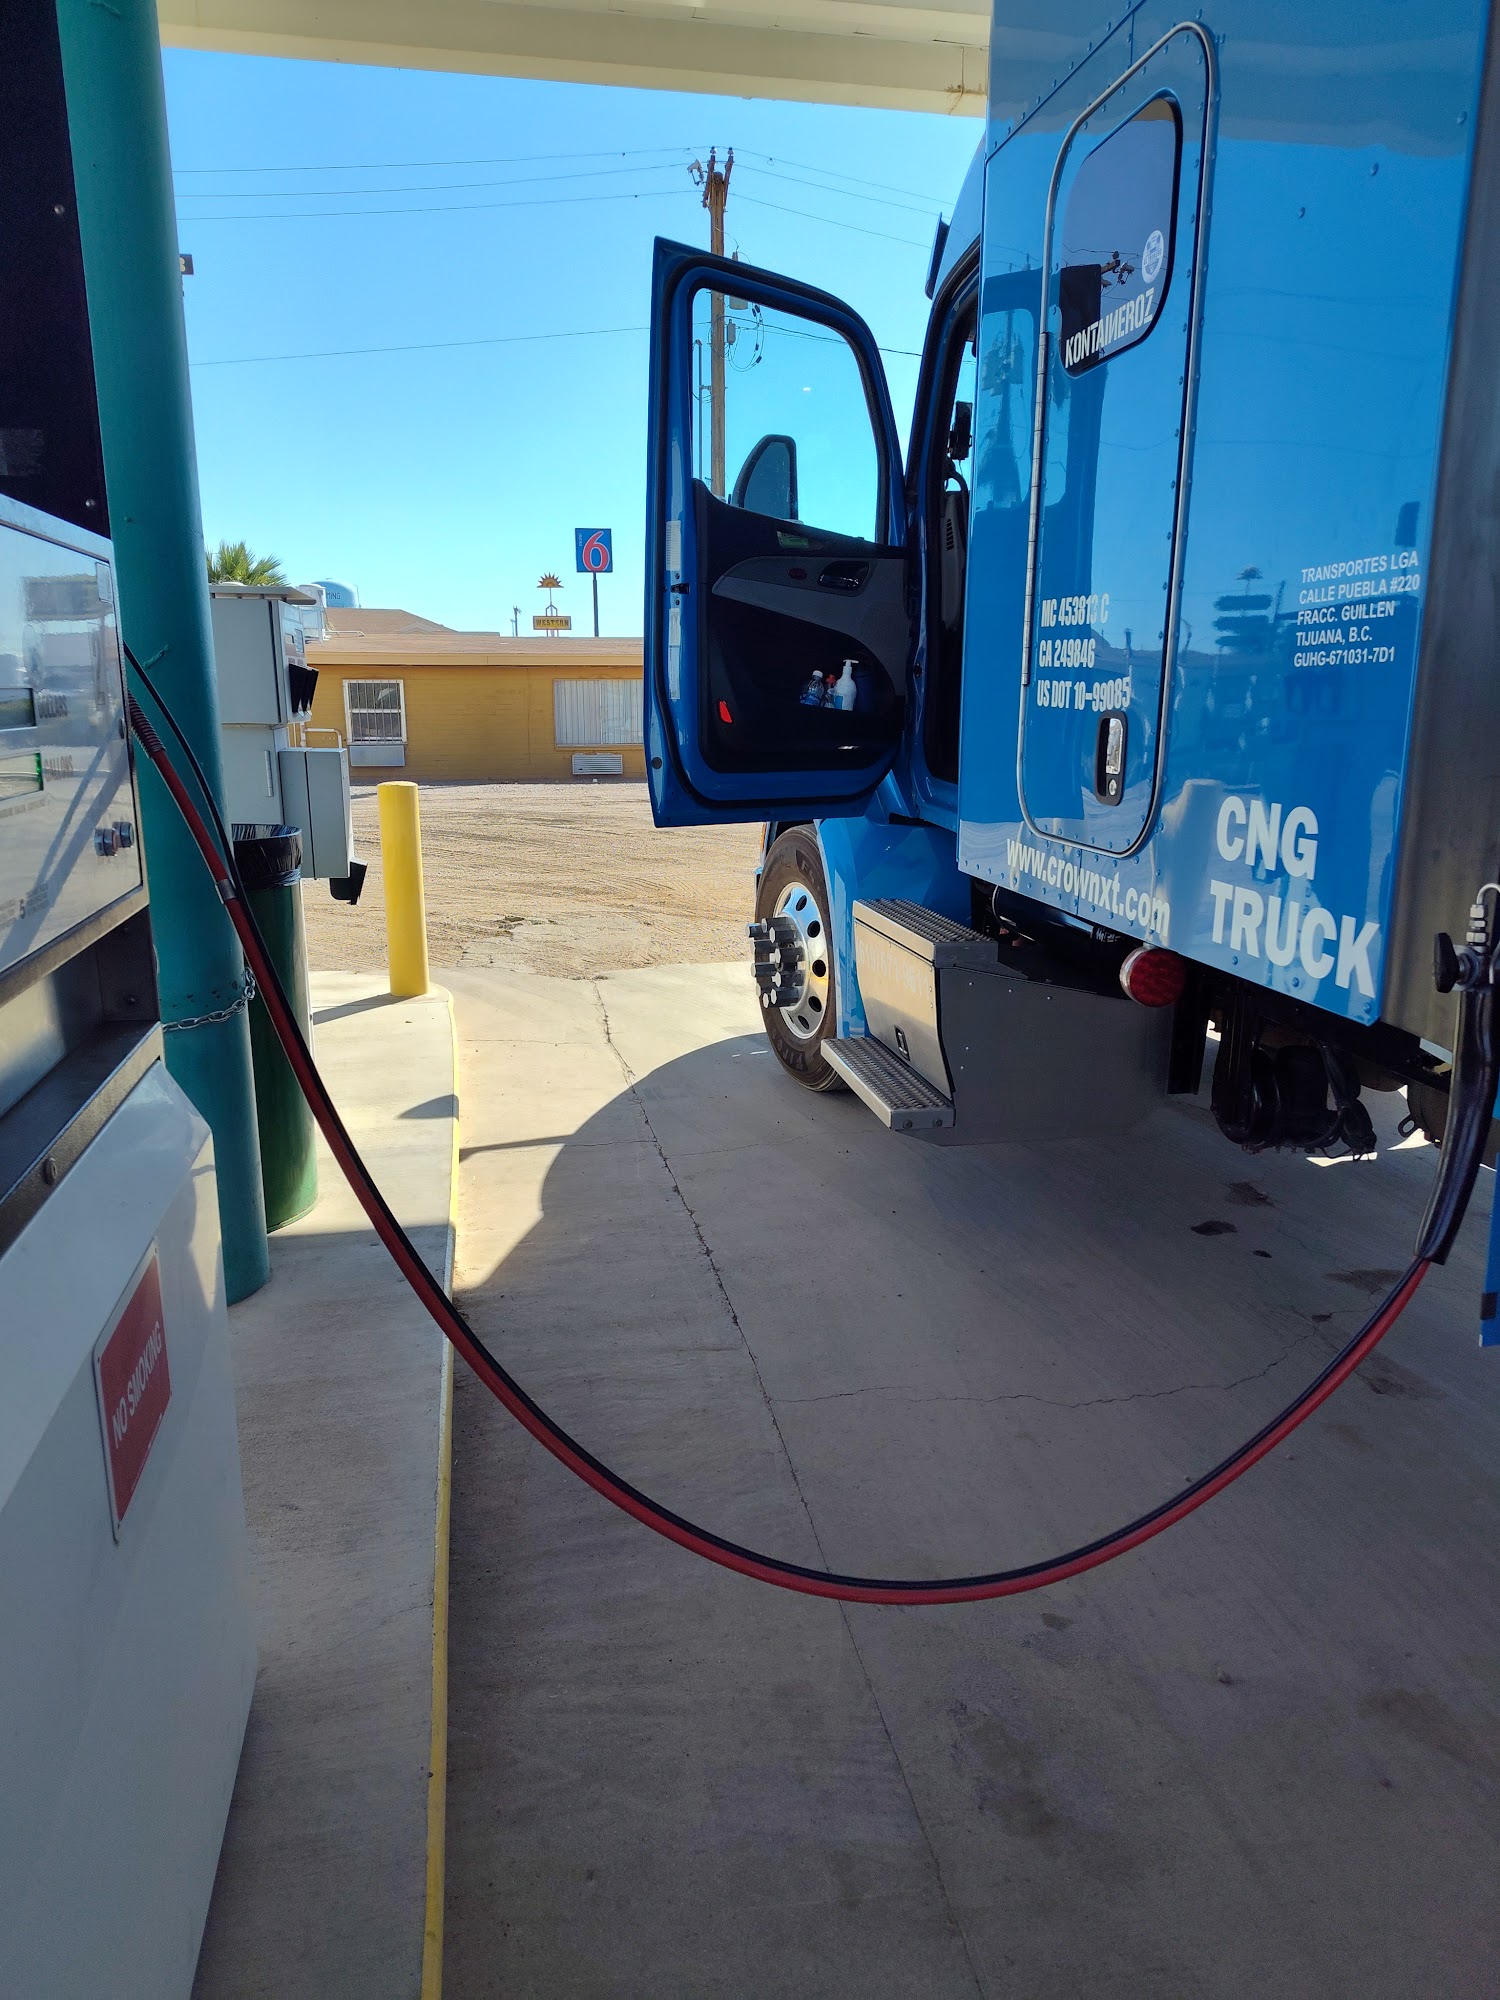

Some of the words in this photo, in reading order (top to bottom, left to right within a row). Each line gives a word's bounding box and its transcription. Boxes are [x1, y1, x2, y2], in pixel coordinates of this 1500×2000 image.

[582, 531, 610, 572] 6
[1301, 555, 1388, 583] TRANSPORTES
[1391, 550, 1419, 570] LGA
[1299, 585, 1336, 605] CALLE
[1337, 578, 1388, 600] PUEBLA
[1389, 573, 1420, 594] #220
[1041, 598, 1057, 628] MC
[1058, 594, 1098, 627] 453813
[1100, 592, 1110, 624] C
[1296, 607, 1339, 626] FRACC.
[1341, 600, 1395, 621] GUILLEN
[1296, 628, 1346, 646] TIJUANA,
[1348, 625, 1373, 643] B.C.
[1039, 640, 1053, 668] CA
[1053, 638, 1096, 669] 249846
[1293, 646, 1396, 668] GUHG-671031-7D1
[1037, 680, 1050, 708] US
[1051, 680, 1073, 709] DOT
[1074, 677, 1131, 712] 10-99085
[1216, 795, 1319, 880] CNG
[1006, 838, 1171, 940] www.crownxt.com
[1210, 879, 1381, 999] TRUCK
[112, 1397, 128, 1450] NO
[127, 1320, 162, 1417] SMOKING
